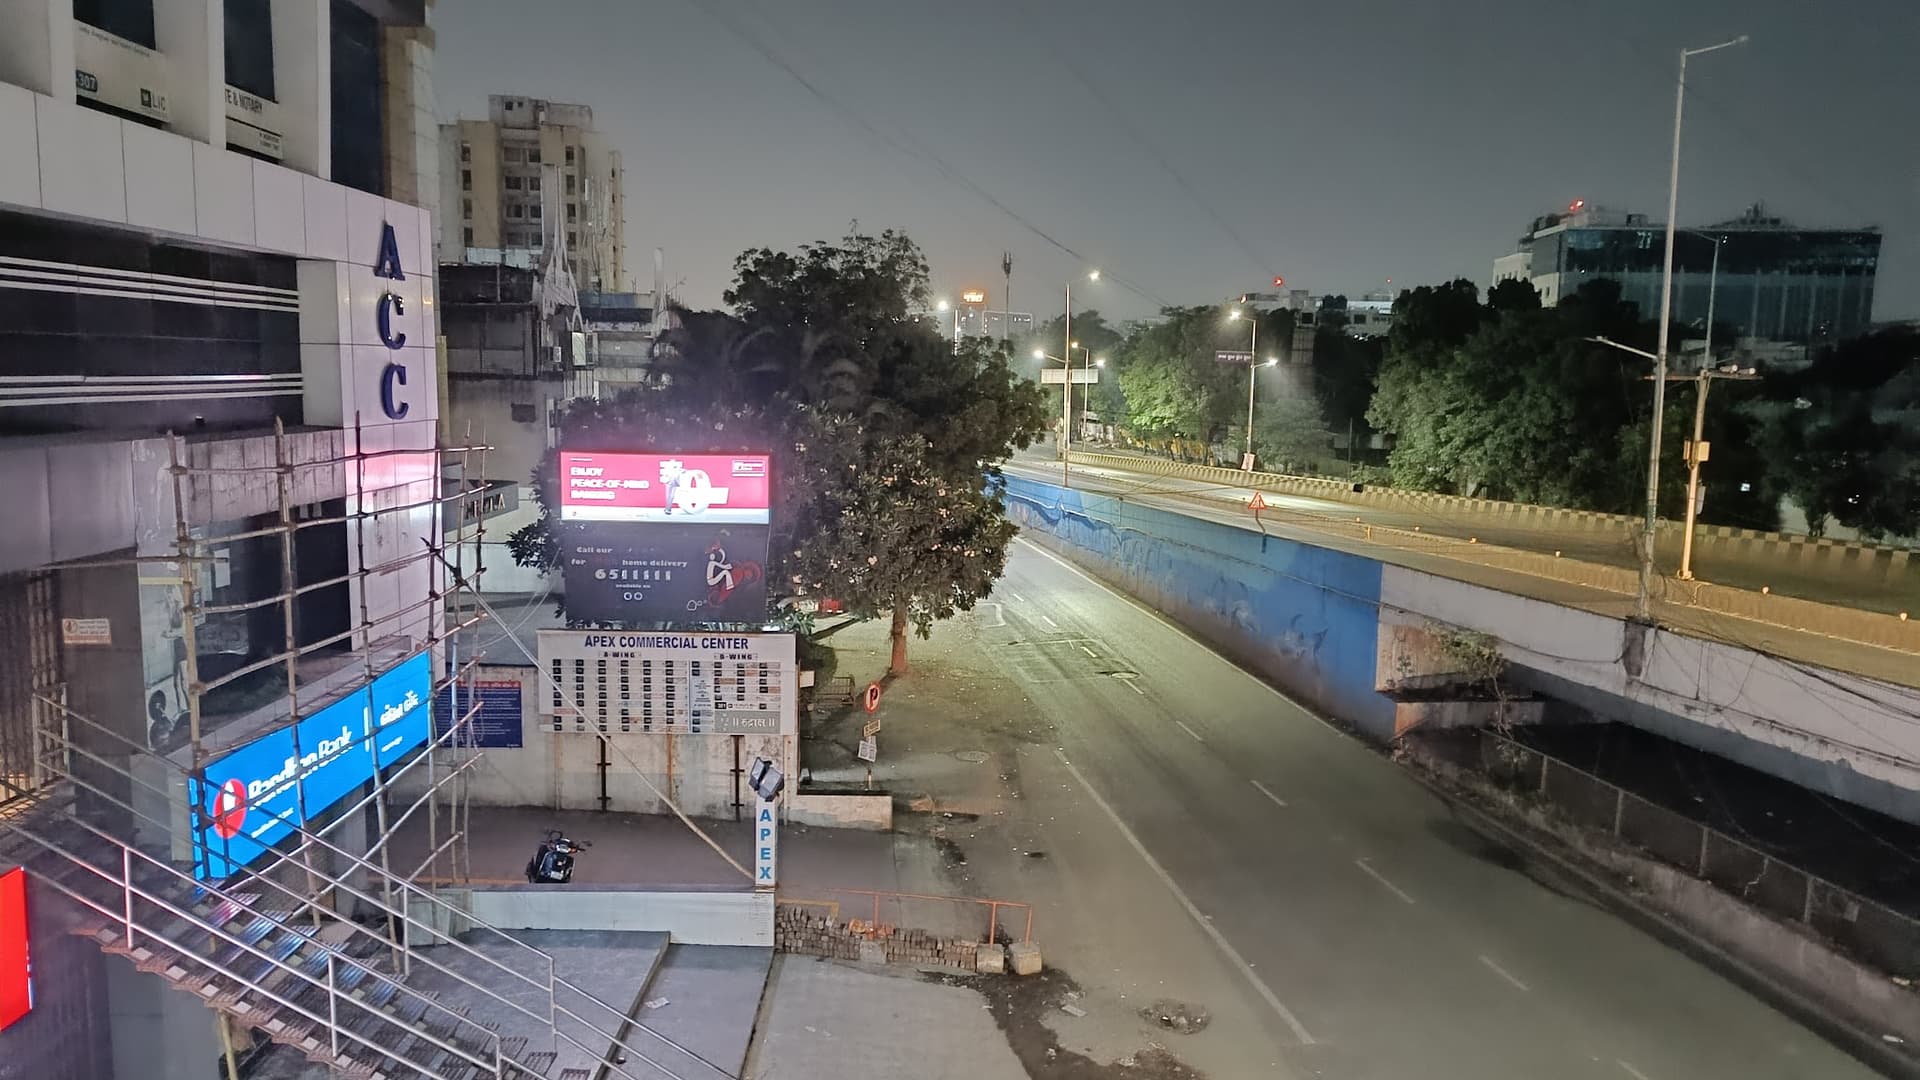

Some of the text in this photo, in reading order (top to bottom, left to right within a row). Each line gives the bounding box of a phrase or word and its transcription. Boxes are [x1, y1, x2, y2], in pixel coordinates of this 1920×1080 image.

[571, 558, 587, 566] for
[622, 559, 648, 567] home
[649, 559, 688, 568] delivery
[584, 635, 749, 650] APEX COMMERCIAL CENTER
[759, 809, 771, 880] APEX
